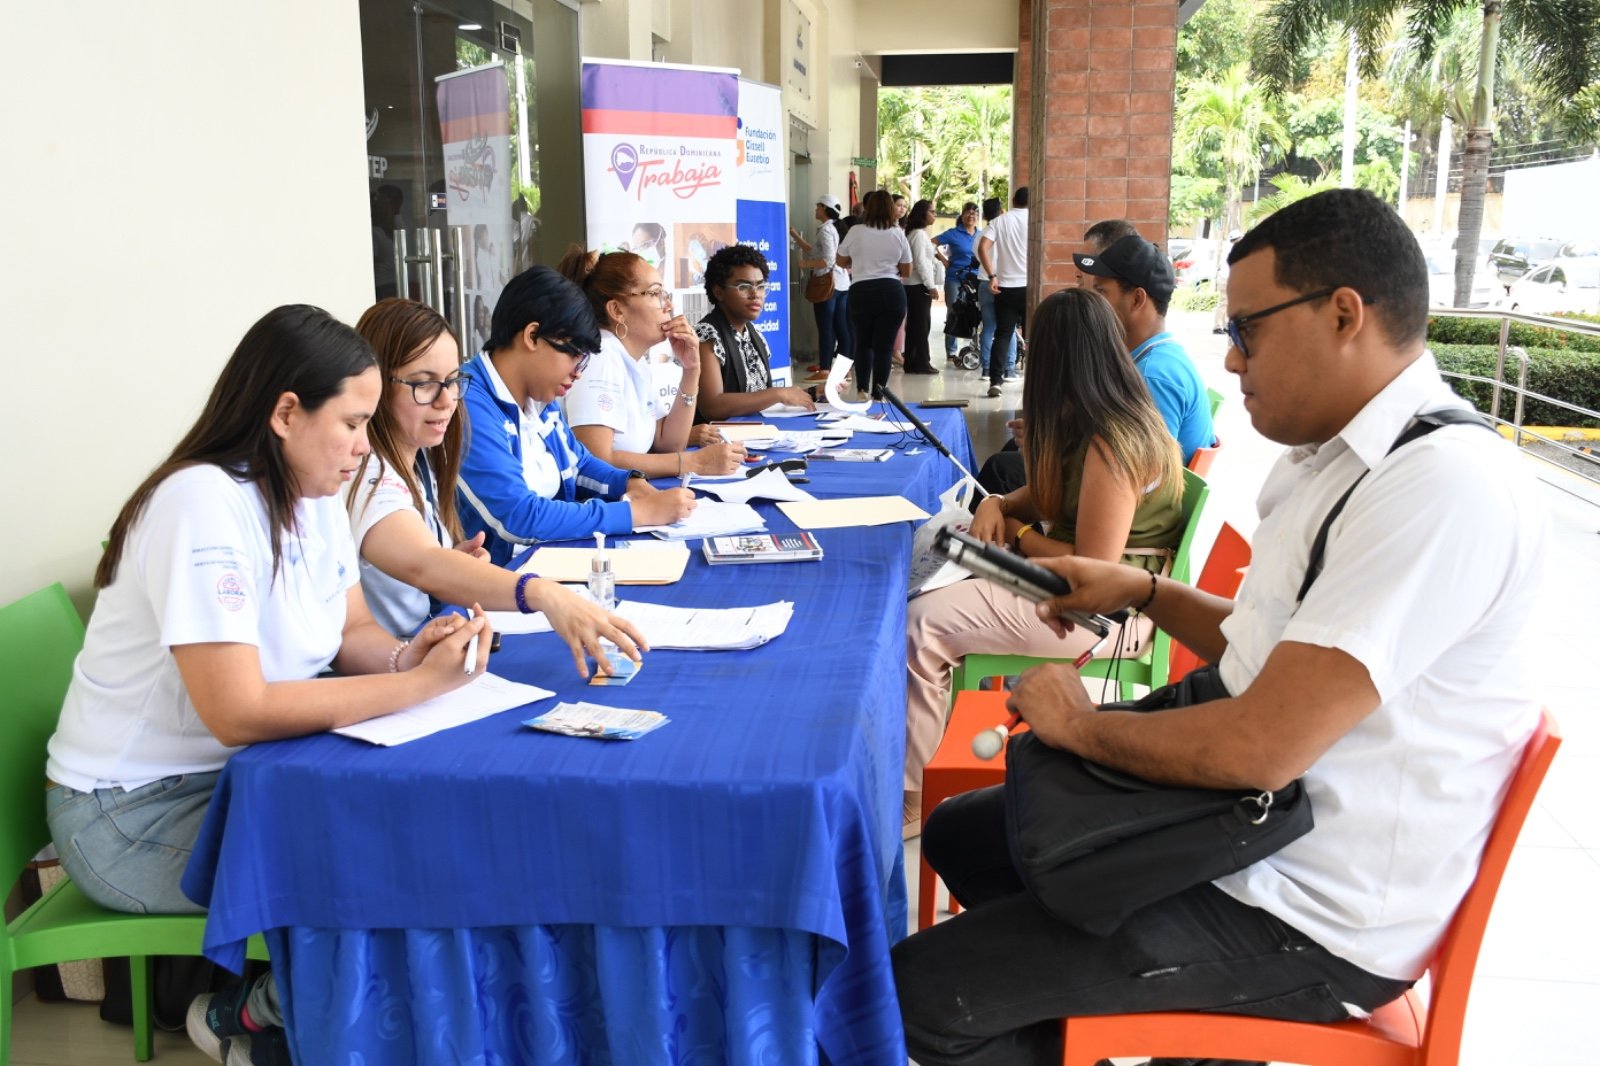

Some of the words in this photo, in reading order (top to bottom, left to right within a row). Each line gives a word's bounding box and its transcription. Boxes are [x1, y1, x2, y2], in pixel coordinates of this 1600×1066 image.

[746, 152, 770, 164] Eusebio
[637, 158, 722, 202] Trabaja
[759, 238, 770, 251] de
[763, 301, 778, 312] con
